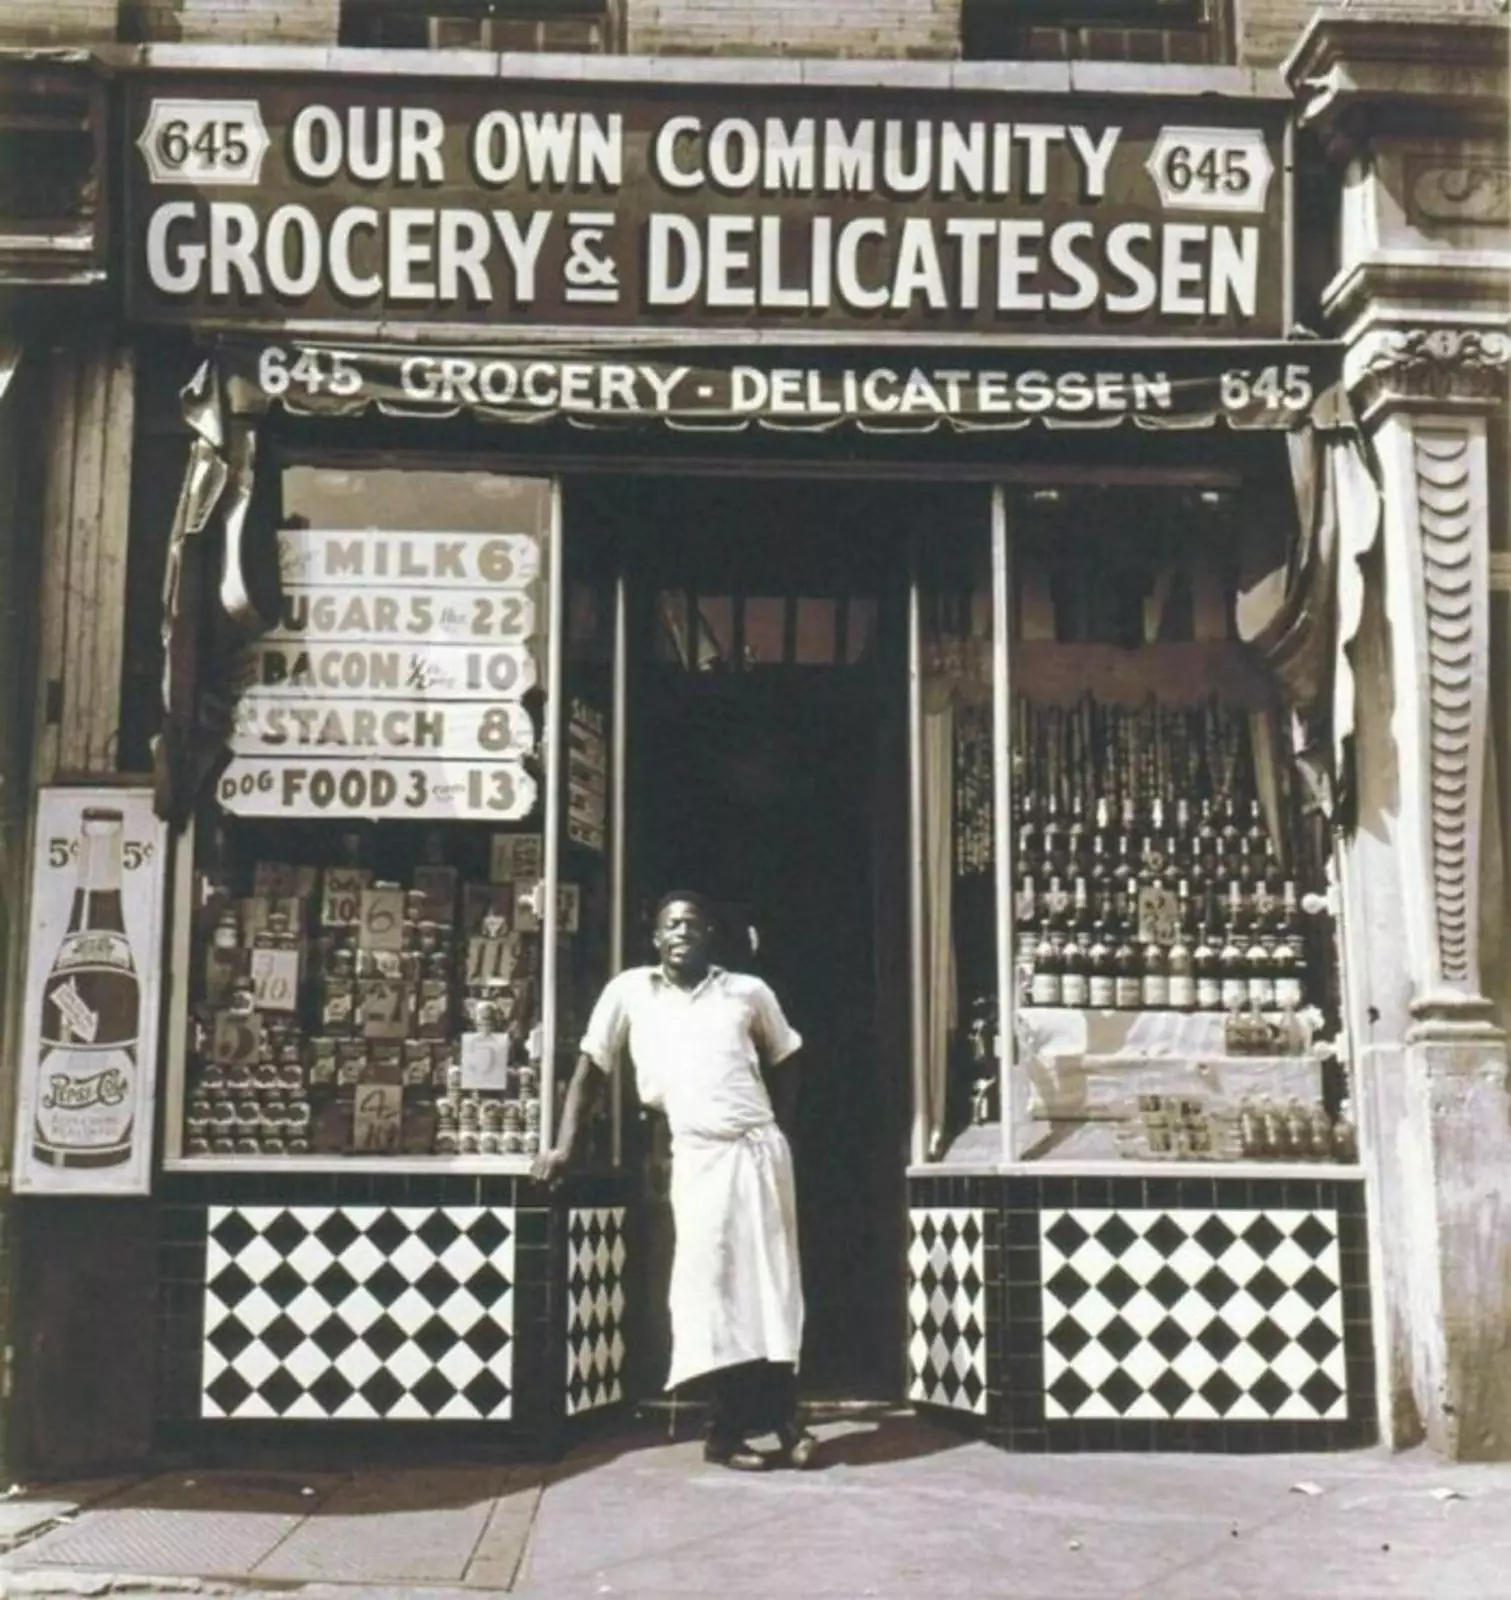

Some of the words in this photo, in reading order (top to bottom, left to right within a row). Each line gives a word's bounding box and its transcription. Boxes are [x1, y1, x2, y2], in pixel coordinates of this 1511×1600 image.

[160, 119, 249, 166] 645
[294, 104, 445, 182] OUR
[474, 110, 622, 186] OWN
[656, 116, 1121, 196] COMMUNITY
[1164, 145, 1251, 194] 645
[147, 201, 552, 301] GROCERY
[565, 227, 619, 286] &
[648, 213, 1258, 316] DELICATESSEN
[259, 346, 363, 395] 645
[401, 355, 690, 411] GROCERY
[731, 365, 1172, 413] DELICATESSEN
[1220, 364, 1313, 411] 645
[324, 540, 468, 579] MILK
[477, 539, 514, 583] 6
[281, 594, 400, 634] UGAR
[405, 596, 433, 635] 5
[470, 597, 523, 635] 22
[262, 651, 400, 690] BACON
[465, 653, 518, 692] 10
[260, 708, 445, 749] STARCH
[477, 707, 512, 752] 8
[220, 769, 274, 801] DOG
[281, 769, 397, 809] FOOD
[404, 769, 429, 809] 3
[467, 769, 516, 811] 13
